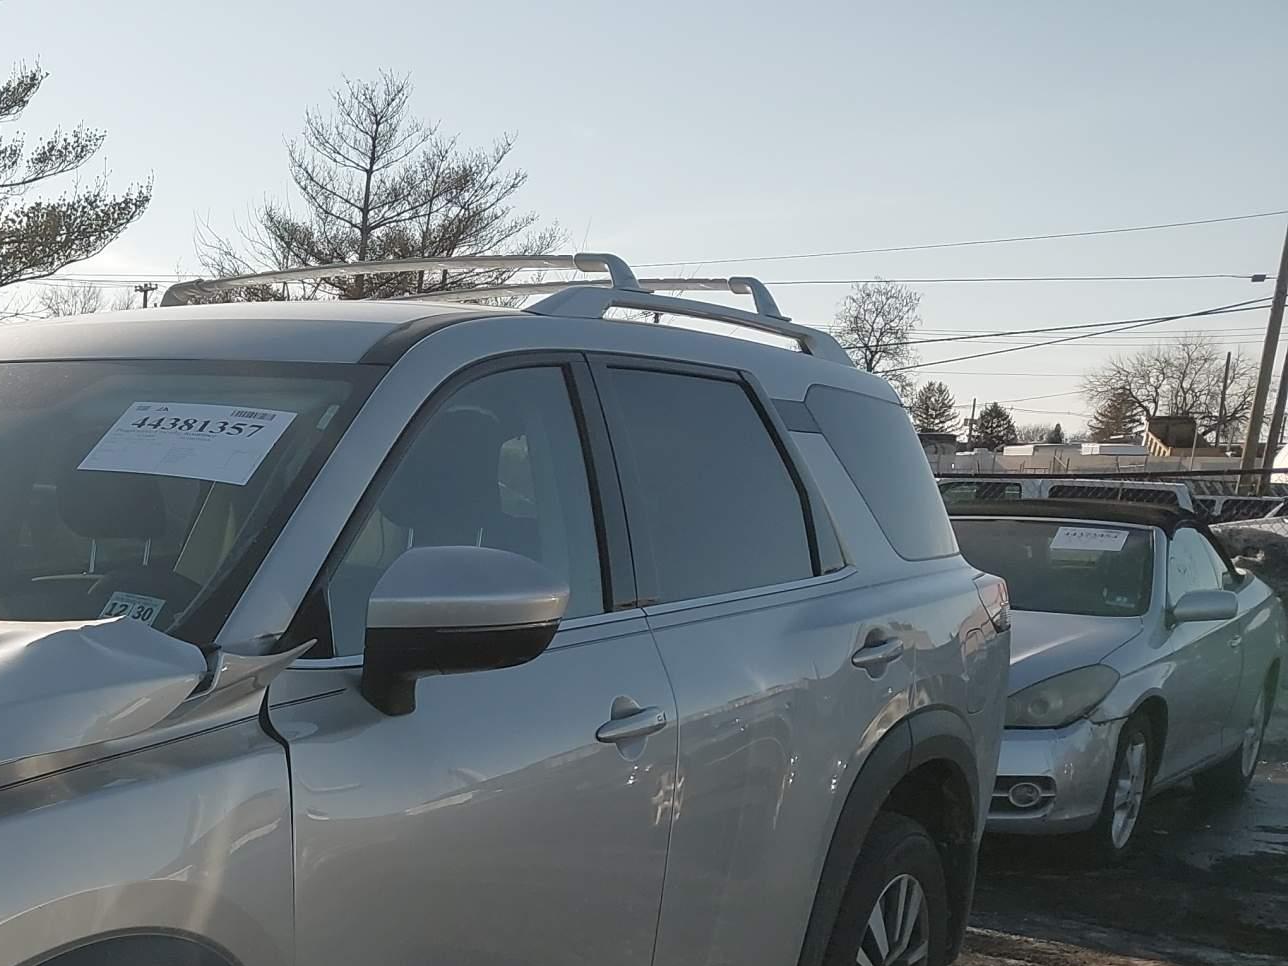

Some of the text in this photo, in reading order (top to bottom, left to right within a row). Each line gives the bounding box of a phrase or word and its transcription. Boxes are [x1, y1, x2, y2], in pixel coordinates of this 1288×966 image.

[131, 415, 264, 438] 44381357
[107, 602, 153, 622] 12 30
